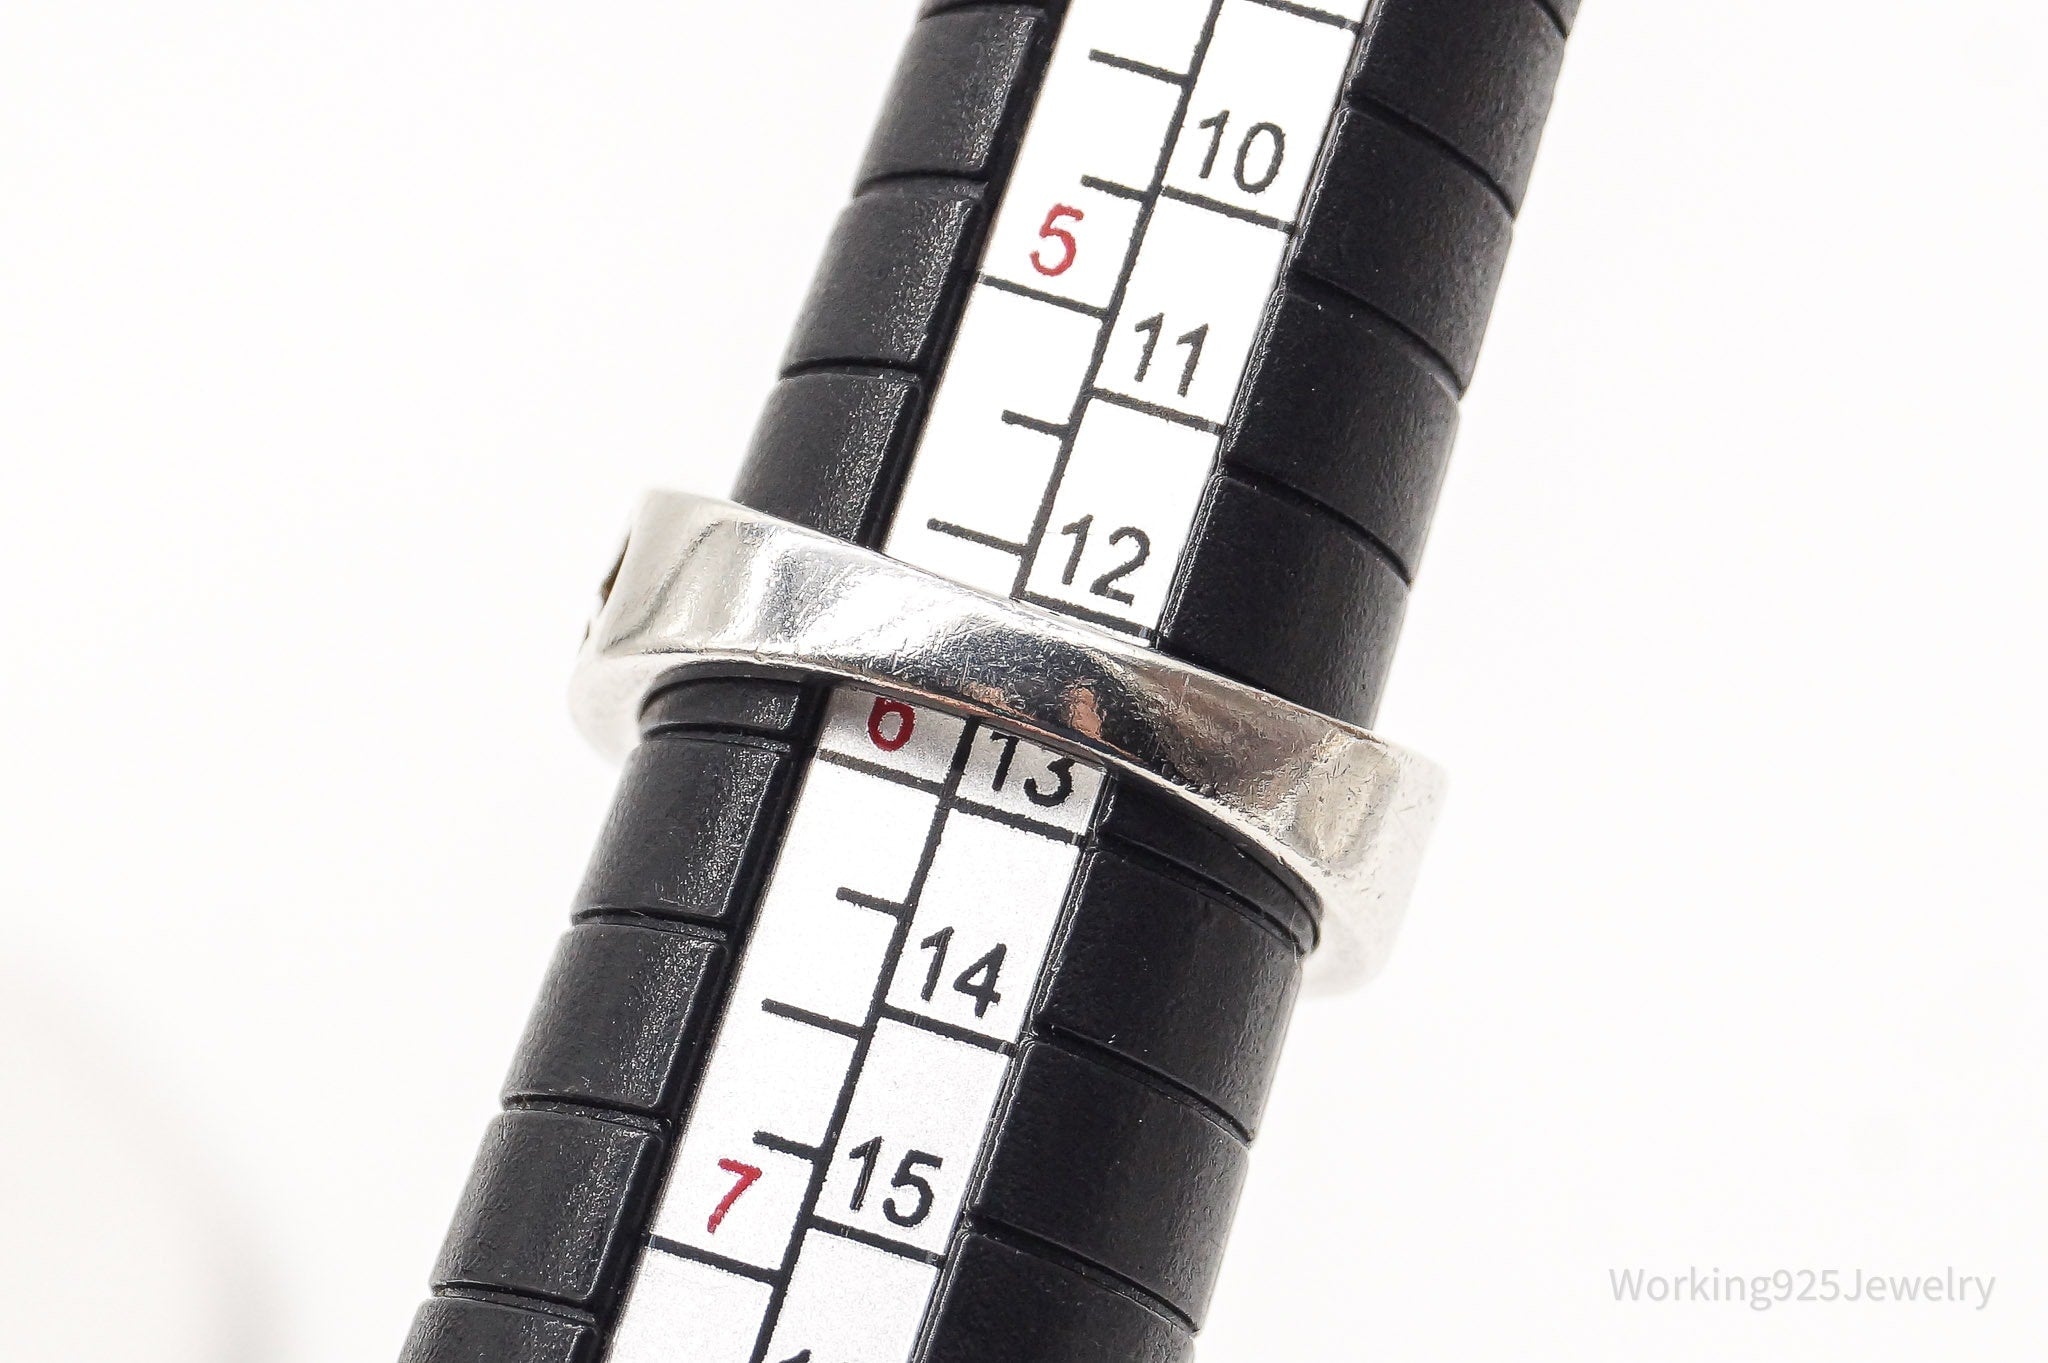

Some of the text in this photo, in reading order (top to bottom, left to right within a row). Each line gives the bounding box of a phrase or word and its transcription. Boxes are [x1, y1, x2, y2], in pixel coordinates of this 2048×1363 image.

[1198, 109, 1286, 194] 10
[1029, 203, 1084, 277] 5
[1134, 311, 1209, 398] 11
[1060, 513, 1152, 605] 12
[990, 730, 1077, 808] 13
[920, 925, 1007, 1019] 14
[706, 1157, 763, 1233] 7
[848, 1135, 943, 1229] 15
